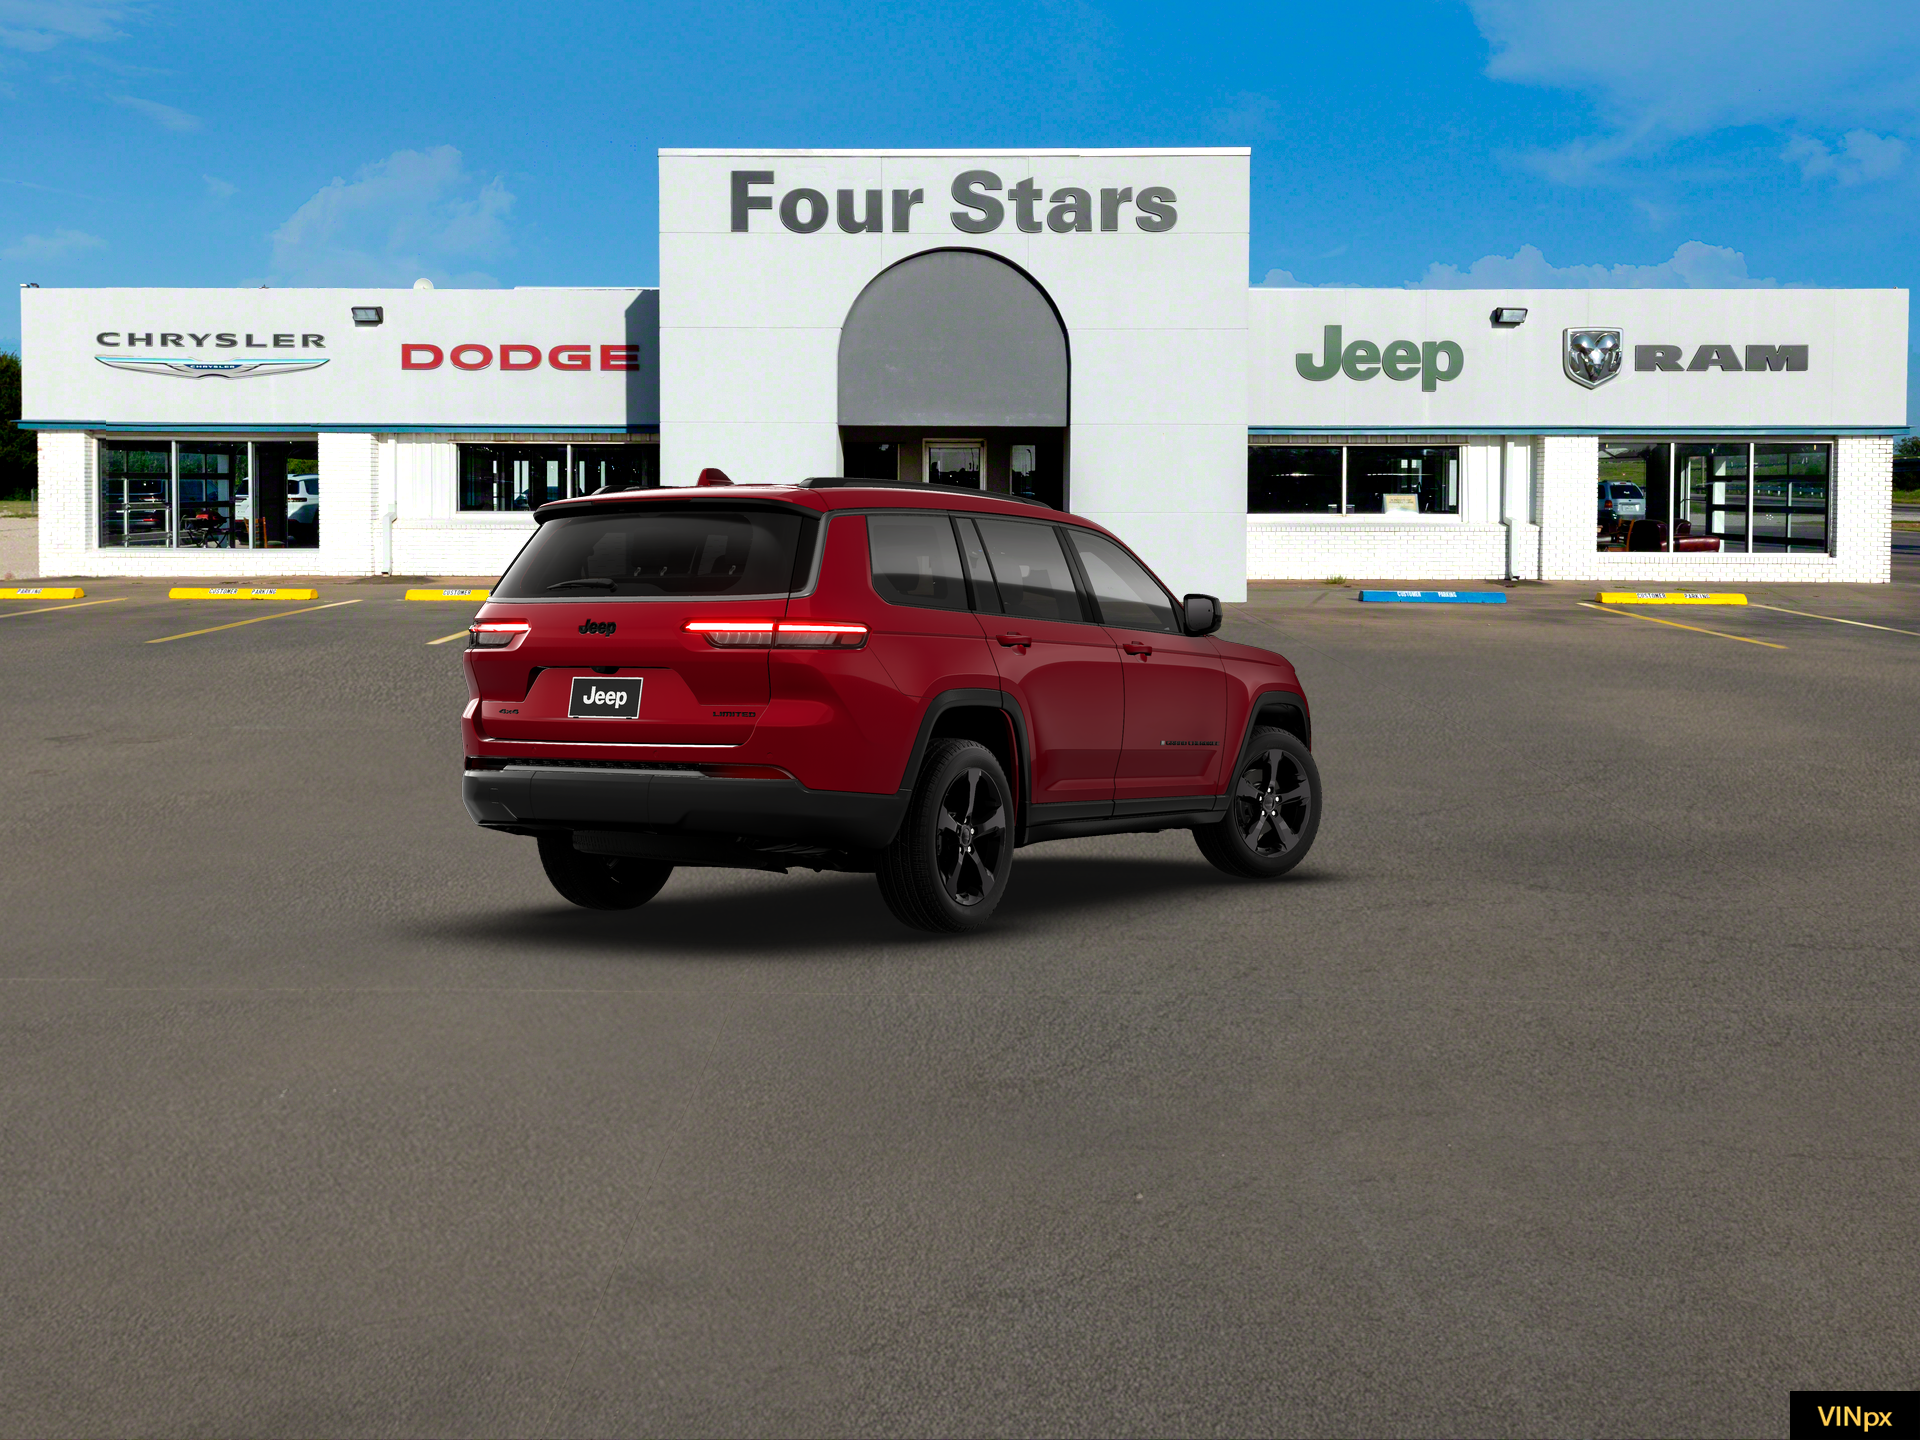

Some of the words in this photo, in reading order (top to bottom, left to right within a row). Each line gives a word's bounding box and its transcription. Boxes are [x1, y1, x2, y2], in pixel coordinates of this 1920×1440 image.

[730, 170, 924, 234] Four
[950, 169, 1178, 234] Stars
[96, 331, 327, 348] CHRYSLER
[401, 343, 640, 371] DODGE
[1295, 324, 1465, 392] Jeep
[1634, 344, 1809, 371] RAM
[578, 618, 617, 637] Jeep
[583, 686, 627, 708] Jeep
